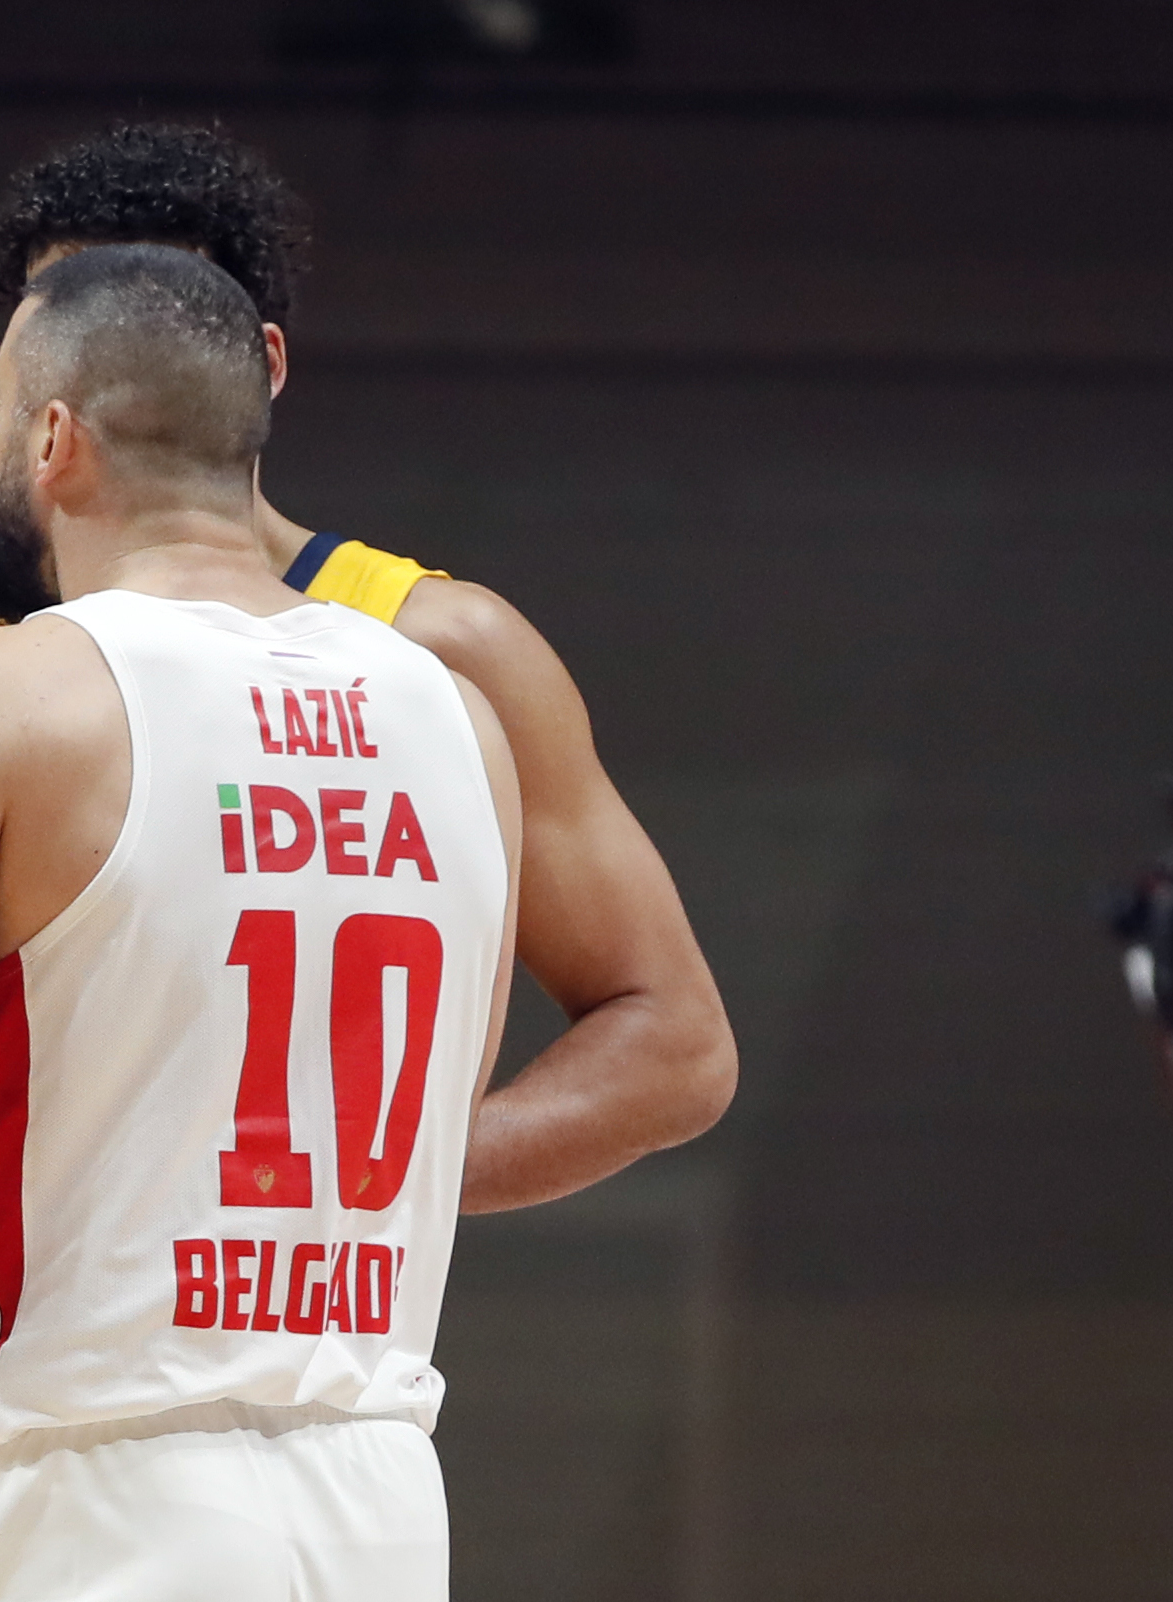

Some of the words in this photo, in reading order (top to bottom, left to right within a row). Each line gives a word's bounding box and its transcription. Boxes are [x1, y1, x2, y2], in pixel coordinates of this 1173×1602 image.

[249, 677, 378, 758] LAZIĆ
[219, 909, 443, 1212] 10
[172, 1239, 405, 1335] BELGAD
